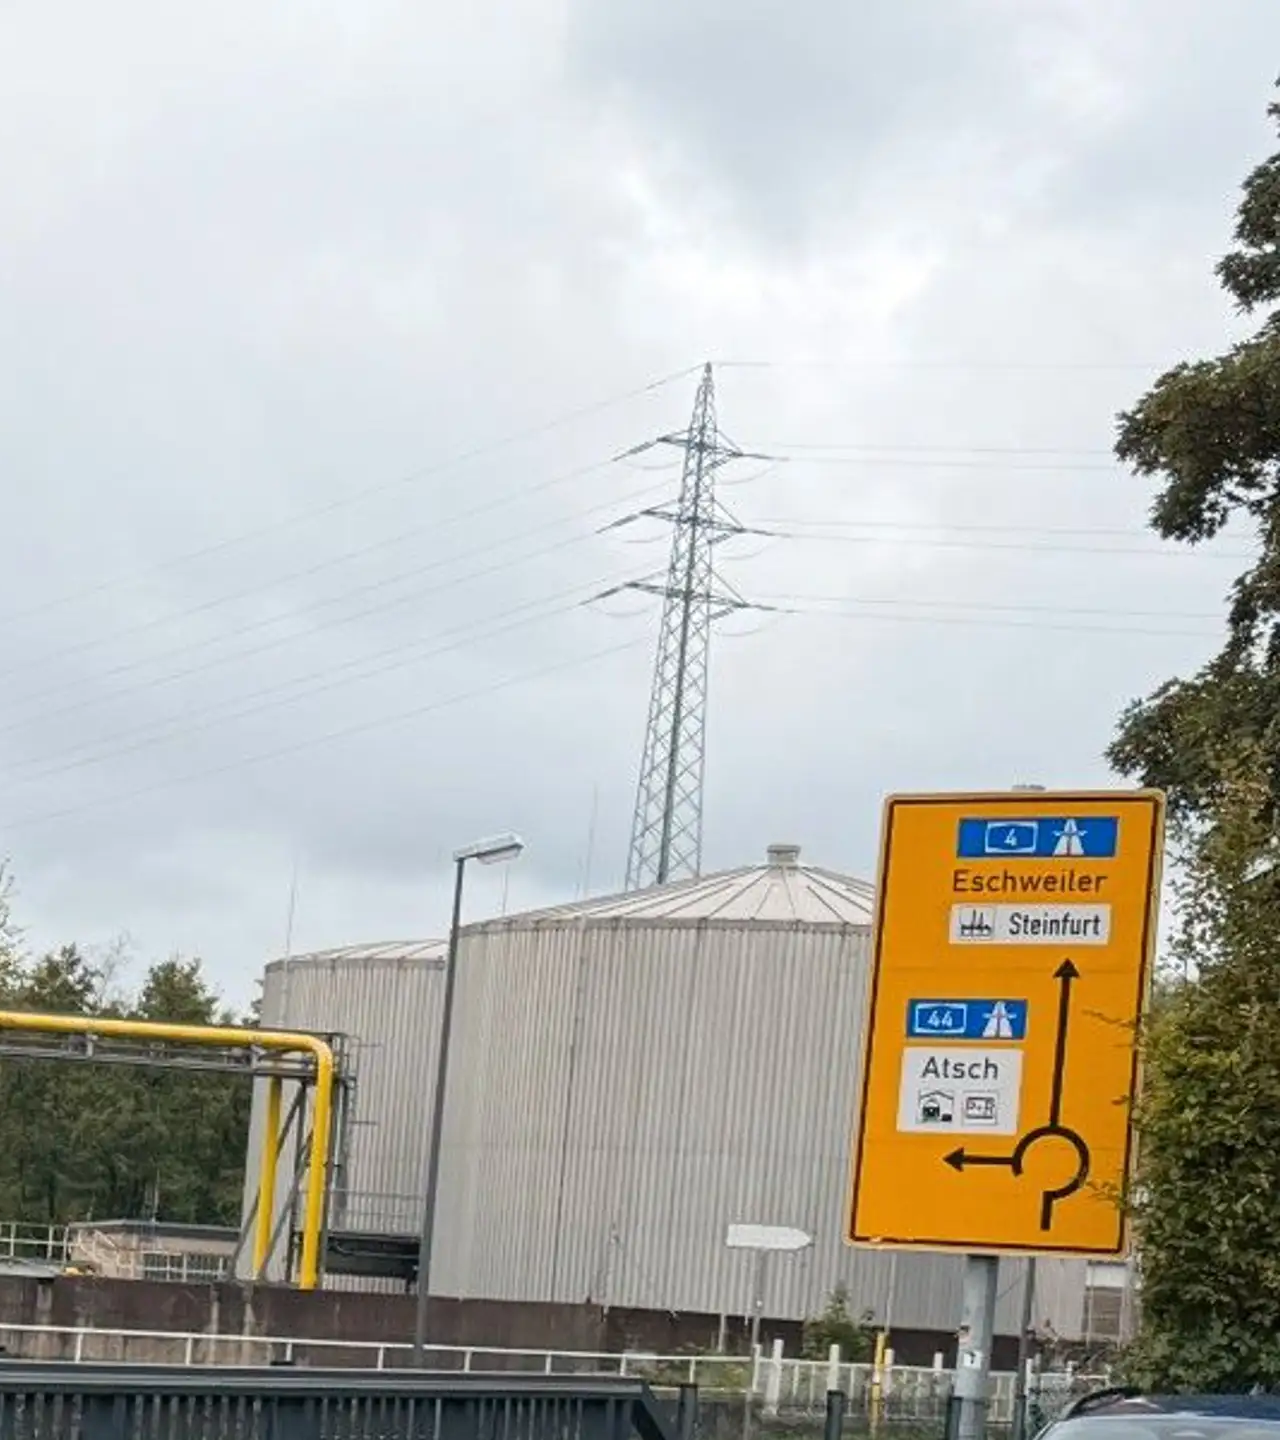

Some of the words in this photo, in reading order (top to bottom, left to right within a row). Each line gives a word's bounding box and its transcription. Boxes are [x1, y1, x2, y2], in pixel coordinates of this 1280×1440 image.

[1003, 827, 1017, 846] 4
[952, 868, 1108, 893] Eschweiler
[1008, 912, 1101, 937] Steinfurt
[927, 1010, 953, 1028] 44
[921, 1055, 999, 1080] Atsch
